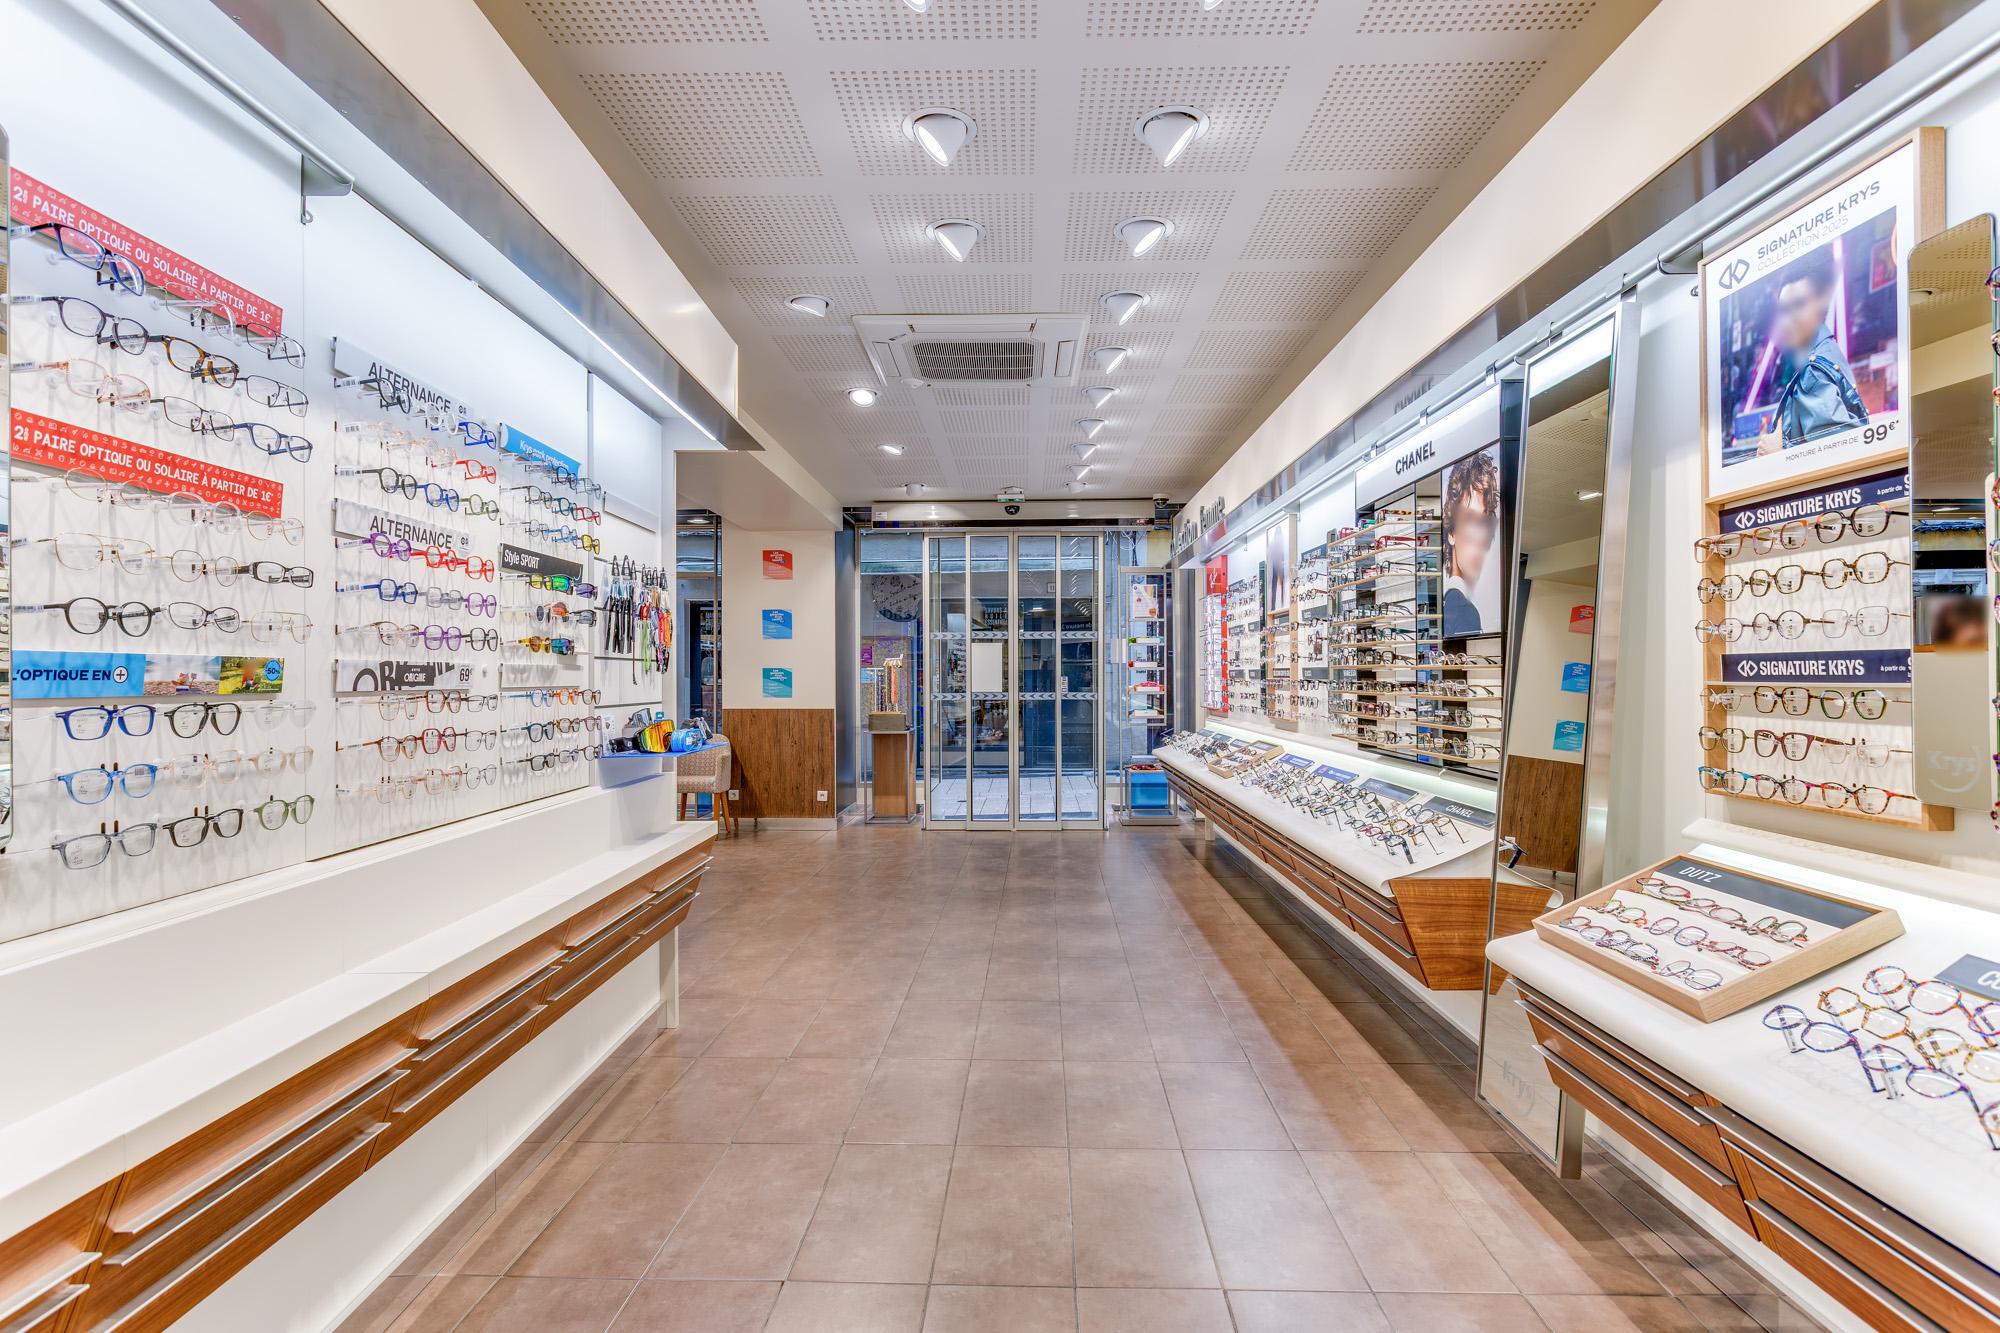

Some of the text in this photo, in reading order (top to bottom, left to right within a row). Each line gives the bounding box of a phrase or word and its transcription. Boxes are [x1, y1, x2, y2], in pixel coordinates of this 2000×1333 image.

[1757, 180, 1881, 260] SIGNATURE KRYS
[32, 194, 76, 228] PAIRE
[78, 218, 133, 256] OPTIQUE
[135, 247, 151, 264] OU
[152, 256, 199, 289] SOLAIRE
[200, 277, 208, 294] À
[209, 284, 245, 312] PARTIR
[246, 302, 258, 318] DE
[1757, 214, 1849, 271] COLLECTION 2025
[368, 361, 452, 413] ALTERNANCE
[33, 430, 77, 453] PAIRE
[80, 443, 133, 468] OPTIQUE
[136, 458, 151, 472] OU
[154, 462, 200, 485] SOLAIRE
[201, 472, 209, 487] À
[210, 477, 245, 496] PARTIR
[247, 486, 259, 499] DE
[1395, 440, 1436, 475] CHANEL
[1785, 449, 1816, 462] MONTURE
[1823, 439, 1848, 451] PARTIR
[1848, 435, 1859, 444] DE
[1756, 487, 1862, 525] SIGNATURE KRYS
[1881, 486, 1895, 496] partir
[370, 515, 453, 549] ALTERNANCE
[504, 549, 540, 569] Style SPORT
[92, 670, 112, 681] EN
[1759, 659, 1827, 676] SIGNATURE
[1829, 659, 1865, 676] KRYS
[1445, 804, 1475, 818] CHANEL
[1678, 866, 1722, 883] DUTZ
